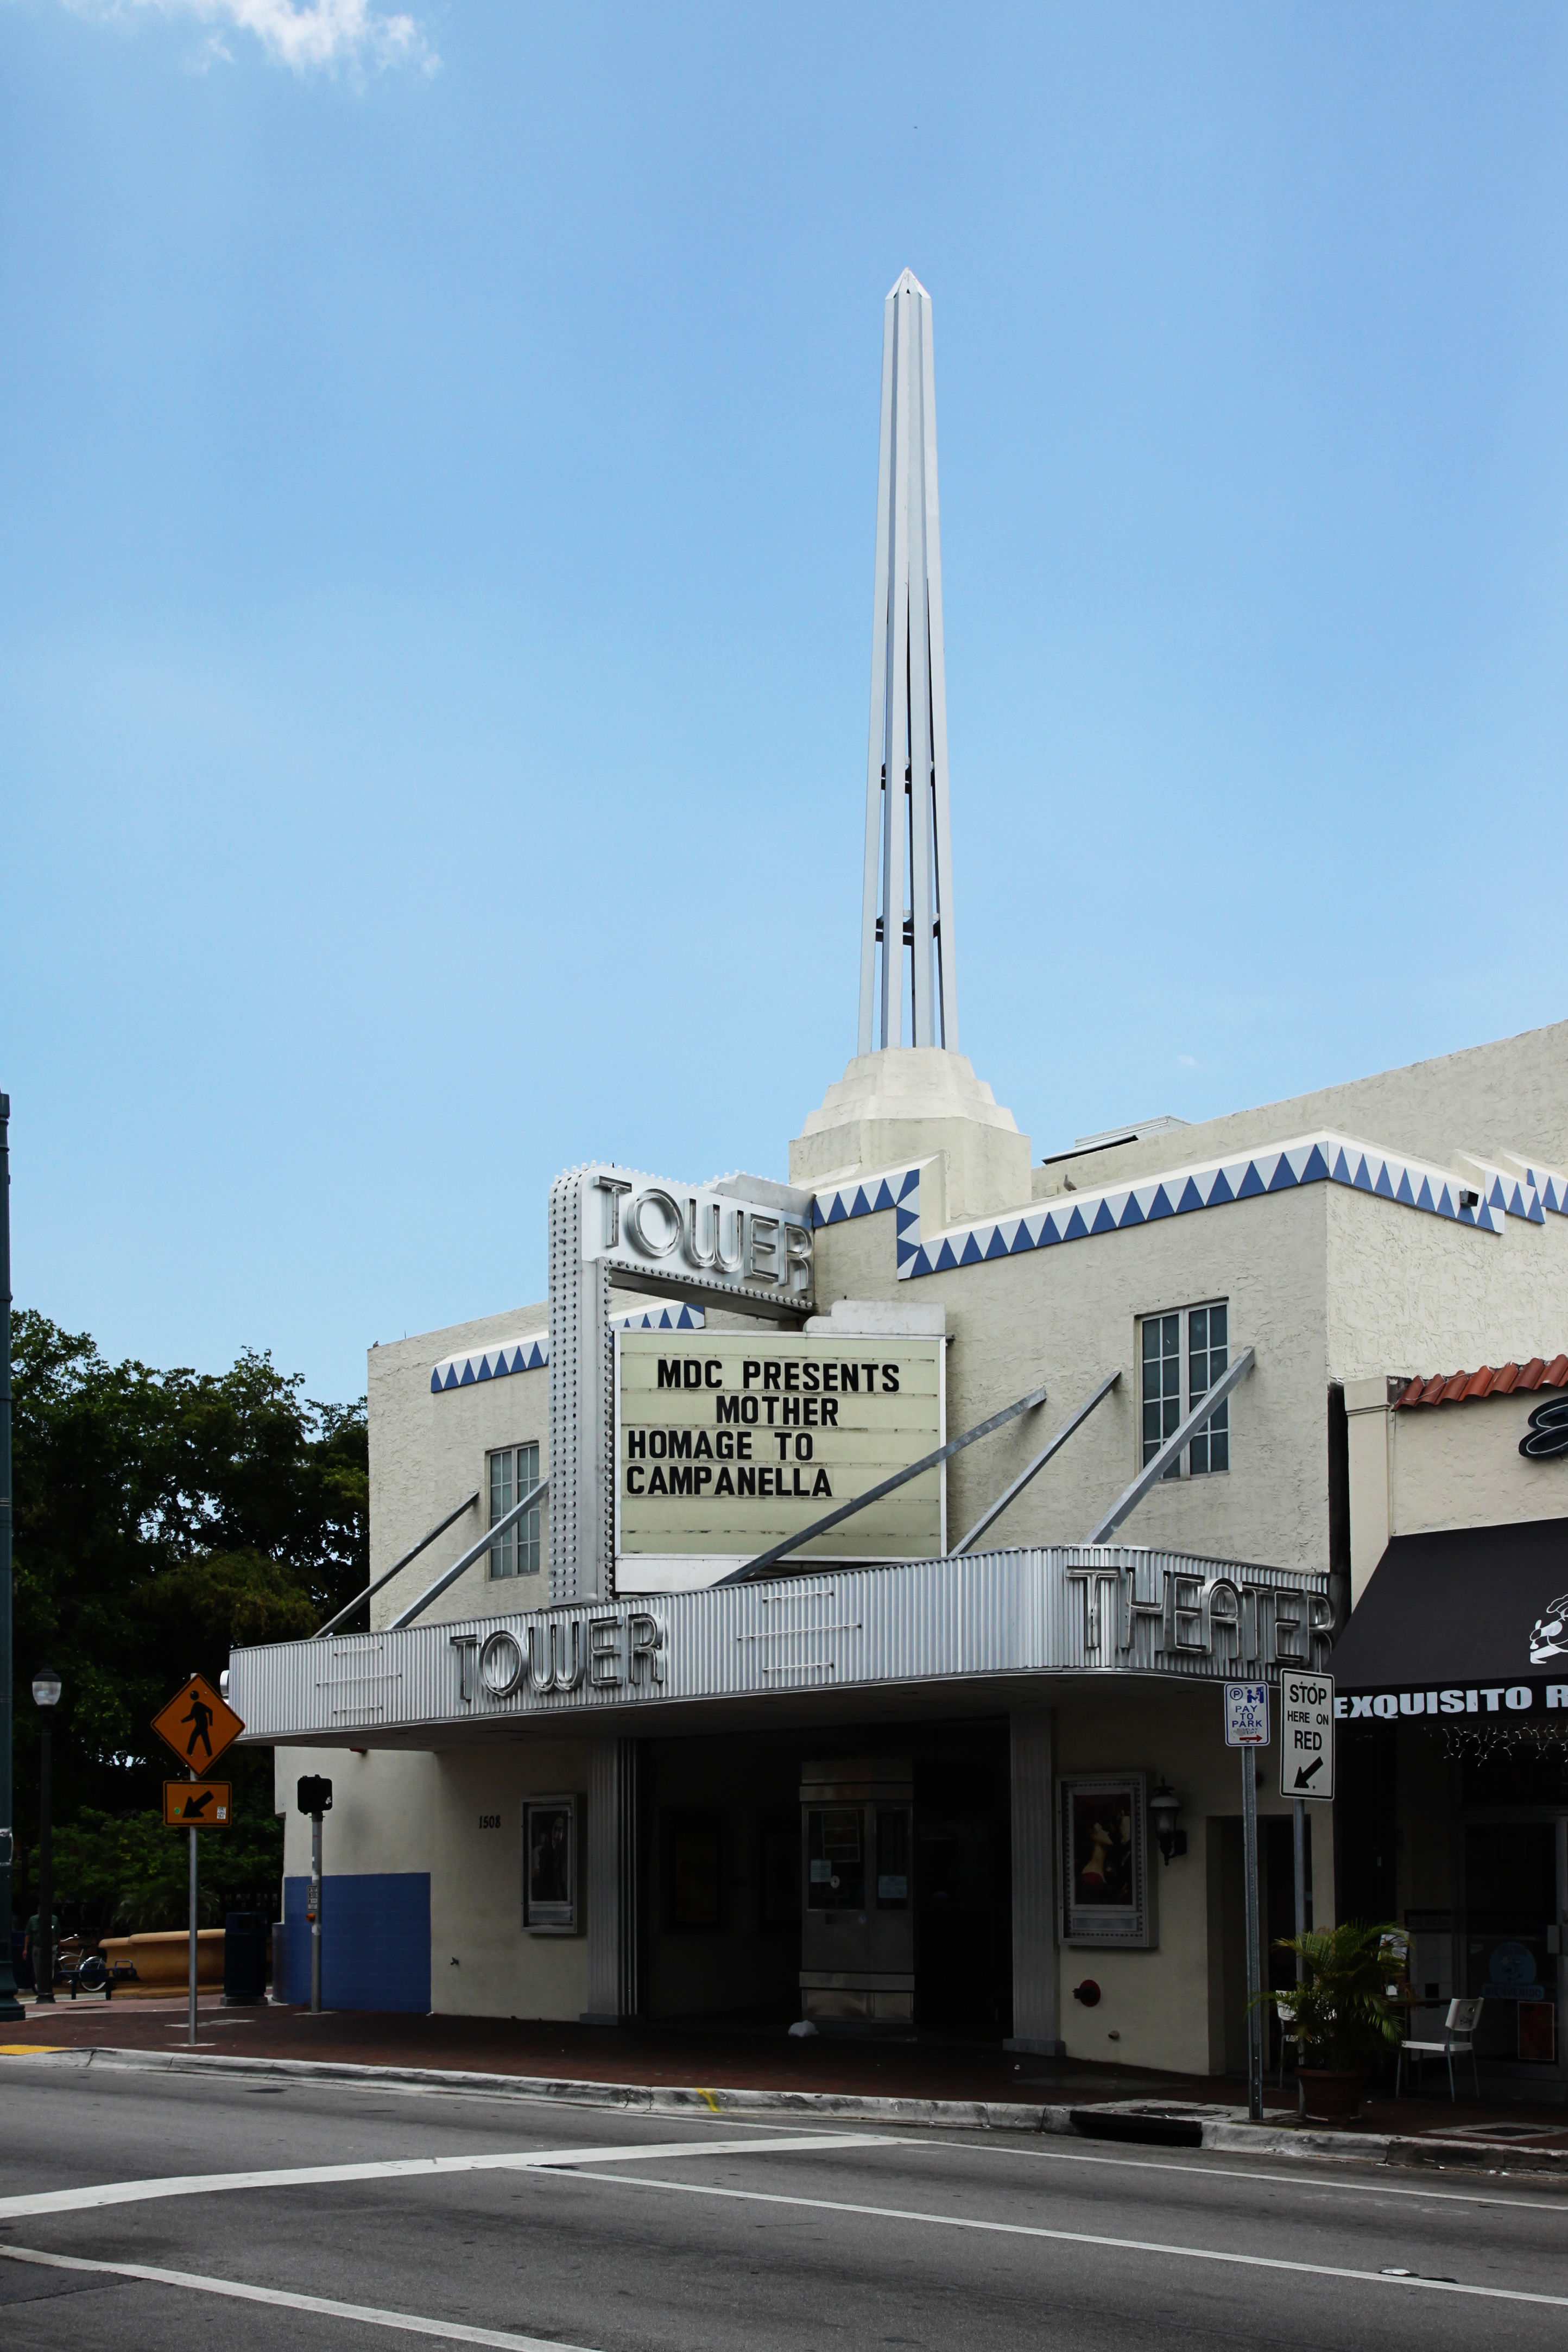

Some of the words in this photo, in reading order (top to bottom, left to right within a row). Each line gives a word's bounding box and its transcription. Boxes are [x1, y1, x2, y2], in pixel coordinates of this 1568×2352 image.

[593, 1175, 814, 1290] TOWER
[657, 1359, 723, 1389] MDC
[743, 1361, 900, 1393] PRESENTS
[716, 1395, 839, 1426] MOTHER
[628, 1431, 753, 1460] HOMAGE
[774, 1432, 813, 1460] TO
[626, 1465, 833, 1497] CAMPANELLA
[1066, 1566, 1336, 1672] THEATER
[450, 1613, 664, 1702] TOWER
[1289, 1685, 1327, 1705] STOP
[1335, 1686, 1533, 1719] EXQUISITO
[1232, 1719, 1262, 1728] PARK
[1287, 1710, 1310, 1724] HERE
[1316, 1714, 1329, 1725] ON
[1294, 1730, 1322, 1751] RED
[479, 1815, 501, 1829] 1508
[1485, 1987, 1541, 1997] BIENVENIDO
